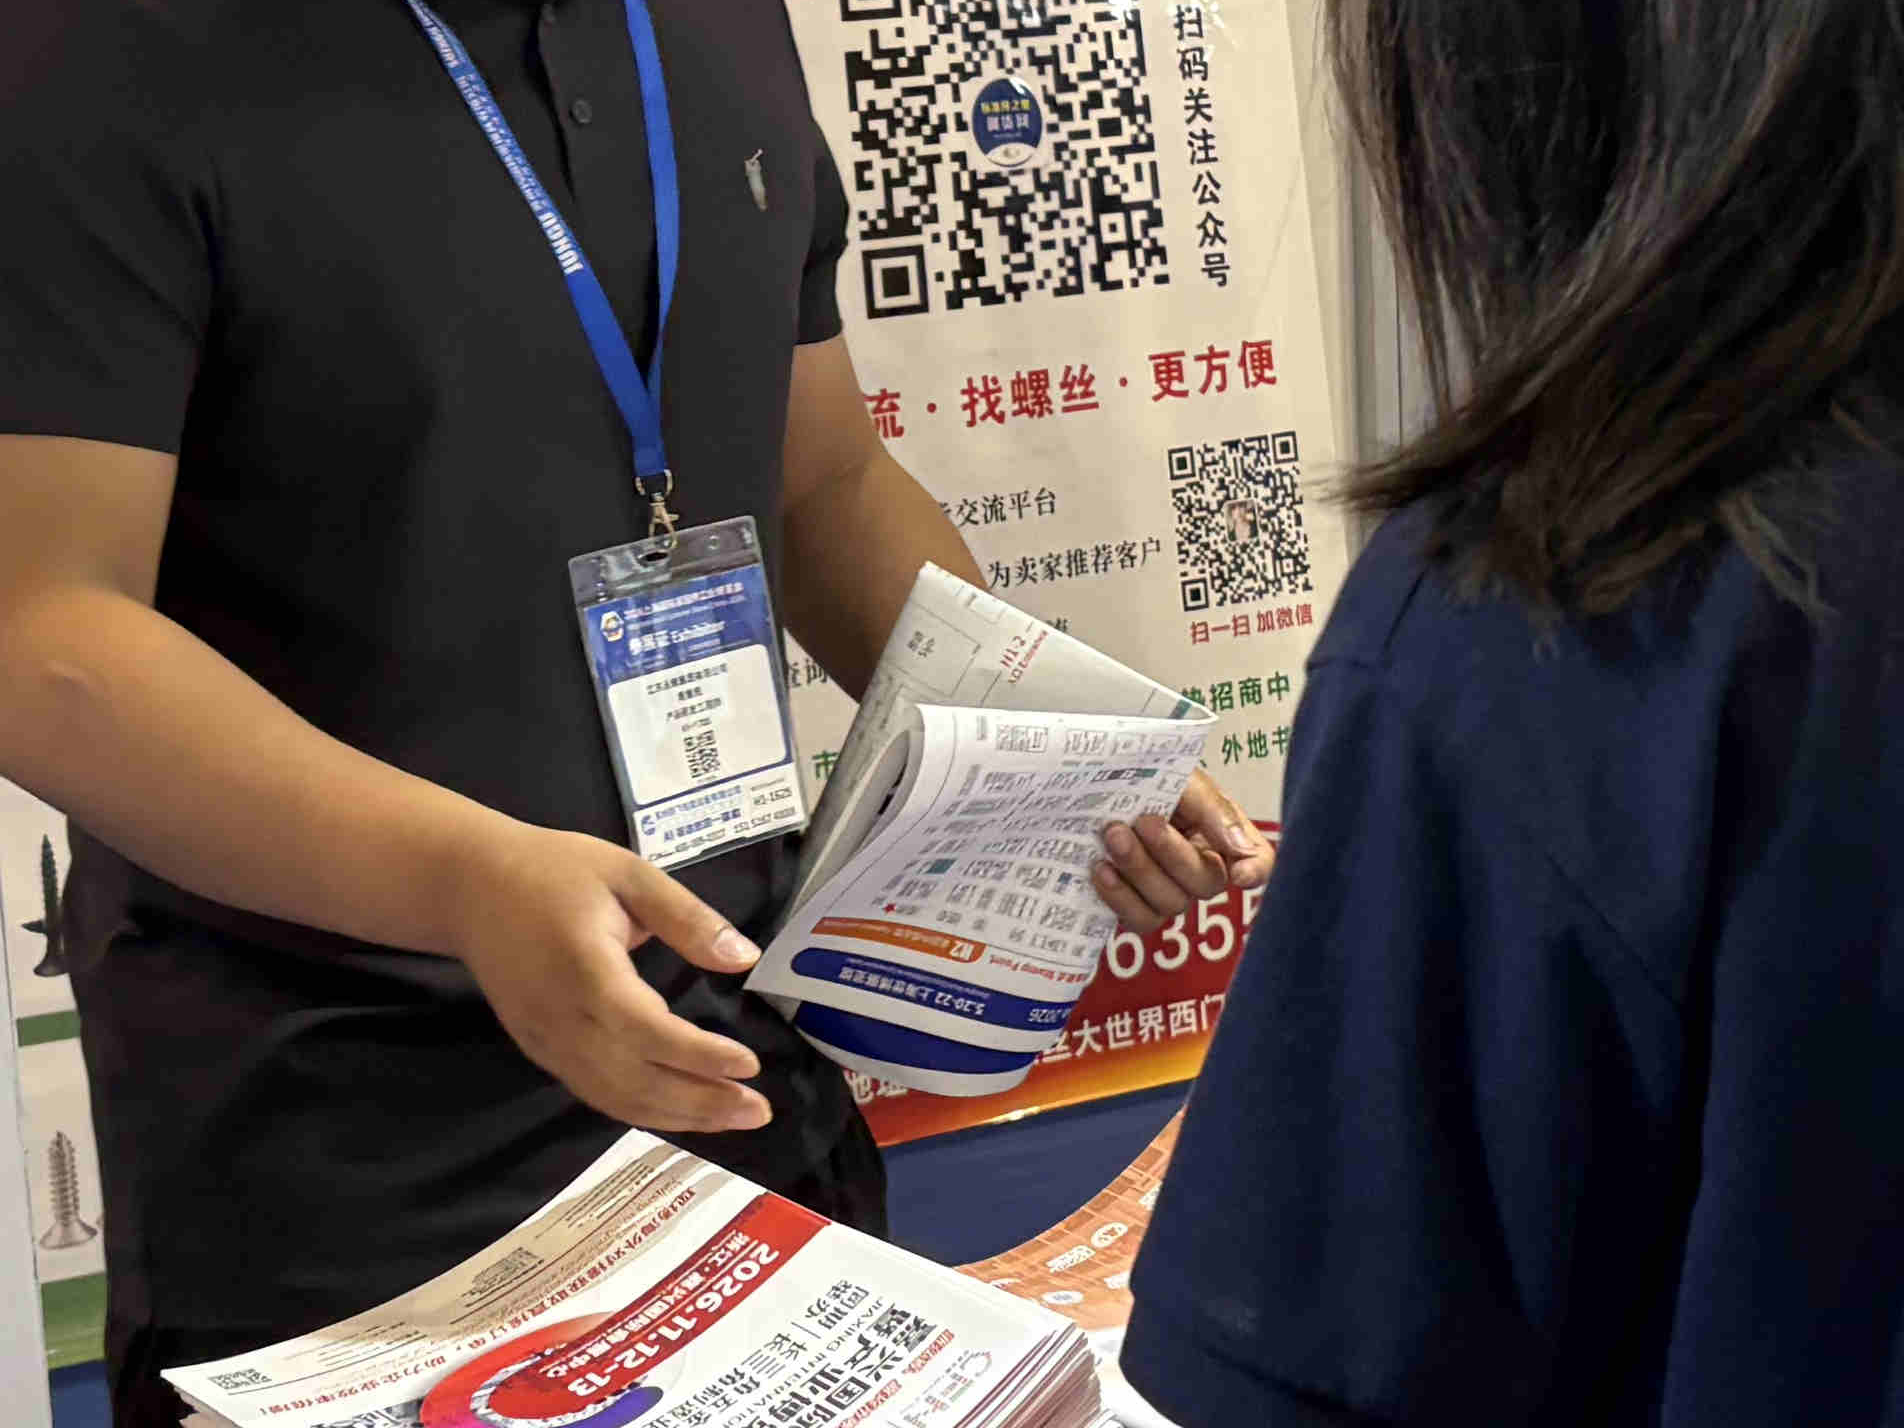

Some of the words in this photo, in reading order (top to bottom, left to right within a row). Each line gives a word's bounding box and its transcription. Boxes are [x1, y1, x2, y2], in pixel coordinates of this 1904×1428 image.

[1172, 3, 1231, 288] 扫码关注公众号
[988, 536, 1162, 590] 为卖家推荐客户
[1190, 615, 1251, 645] 扫一扫
[1256, 603, 1314, 636] 加微信
[935, 989, 986, 1016] 5.20-22
[566, 1241, 780, 1401] 2026.11.12-13
[816, 1285, 870, 1329] 同期
[824, 1296, 886, 1355] JIAXING
